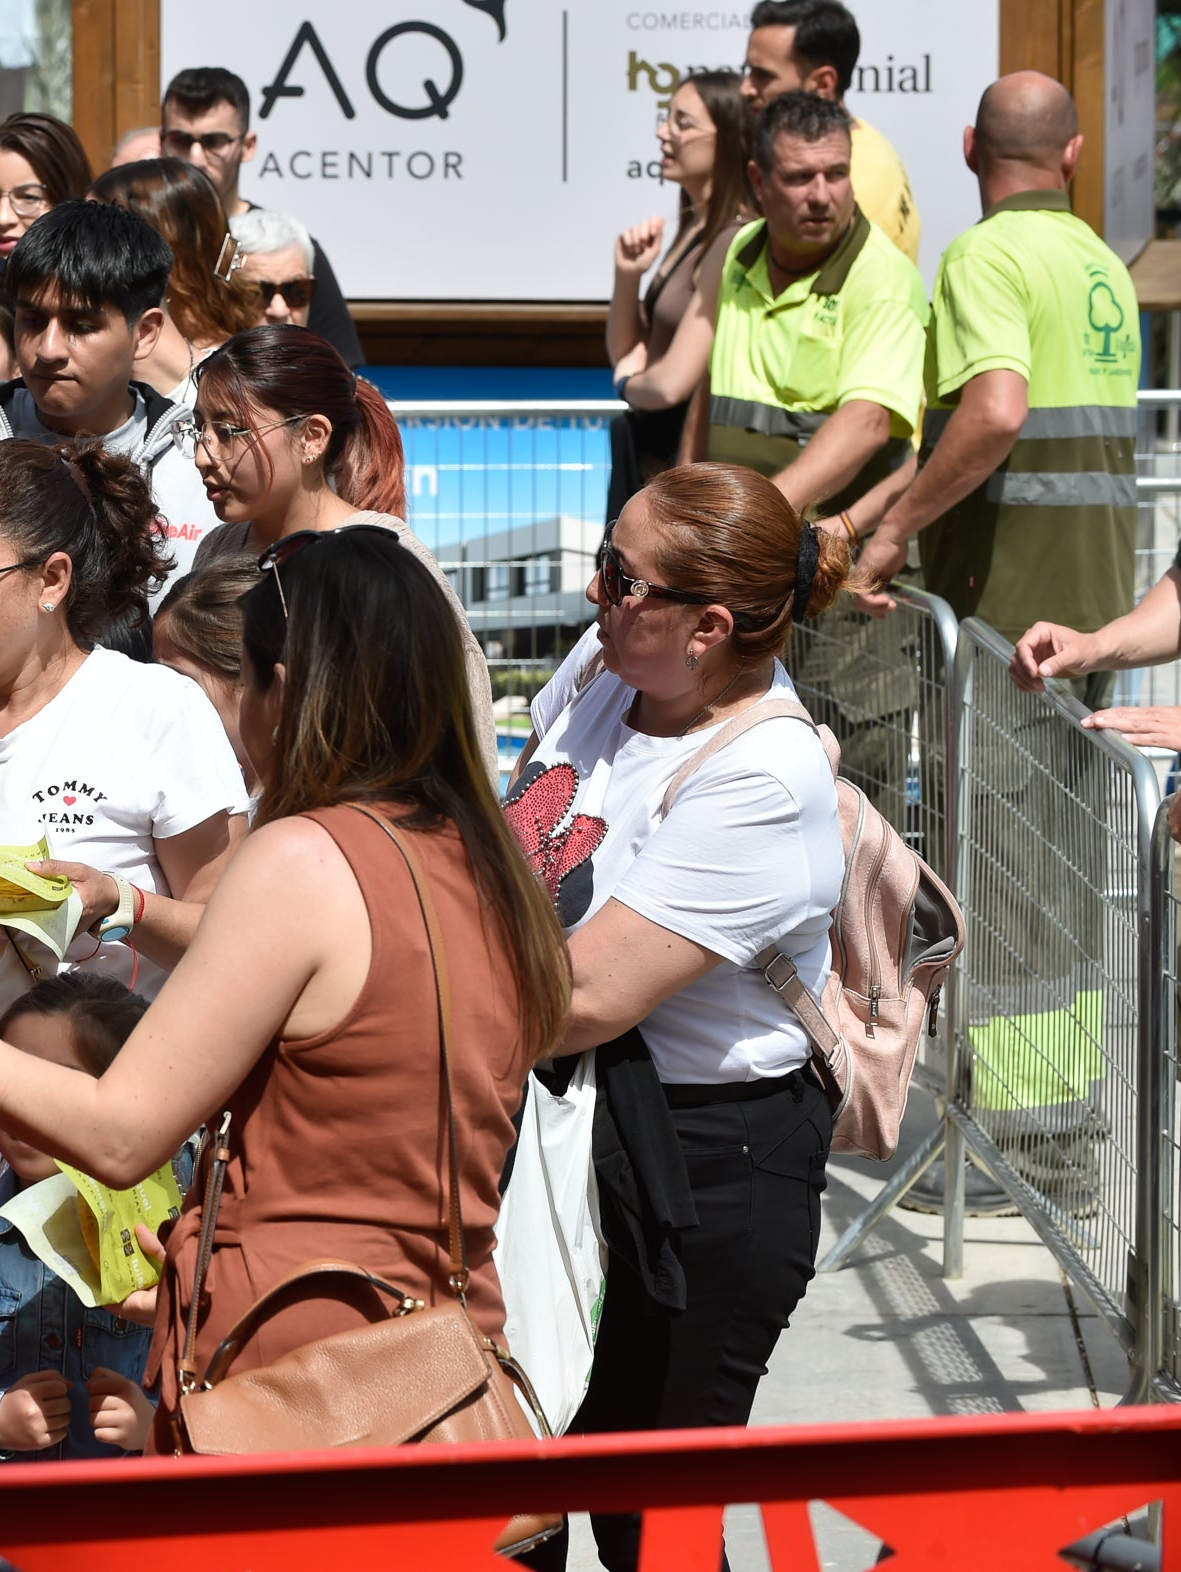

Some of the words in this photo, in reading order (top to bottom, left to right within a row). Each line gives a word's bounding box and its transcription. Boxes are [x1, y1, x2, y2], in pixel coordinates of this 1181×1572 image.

[259, 20, 463, 120] AQ
[259, 151, 464, 179] ACENTOR
[32, 780, 108, 803] TOMMY
[38, 813, 94, 826] JEANS
